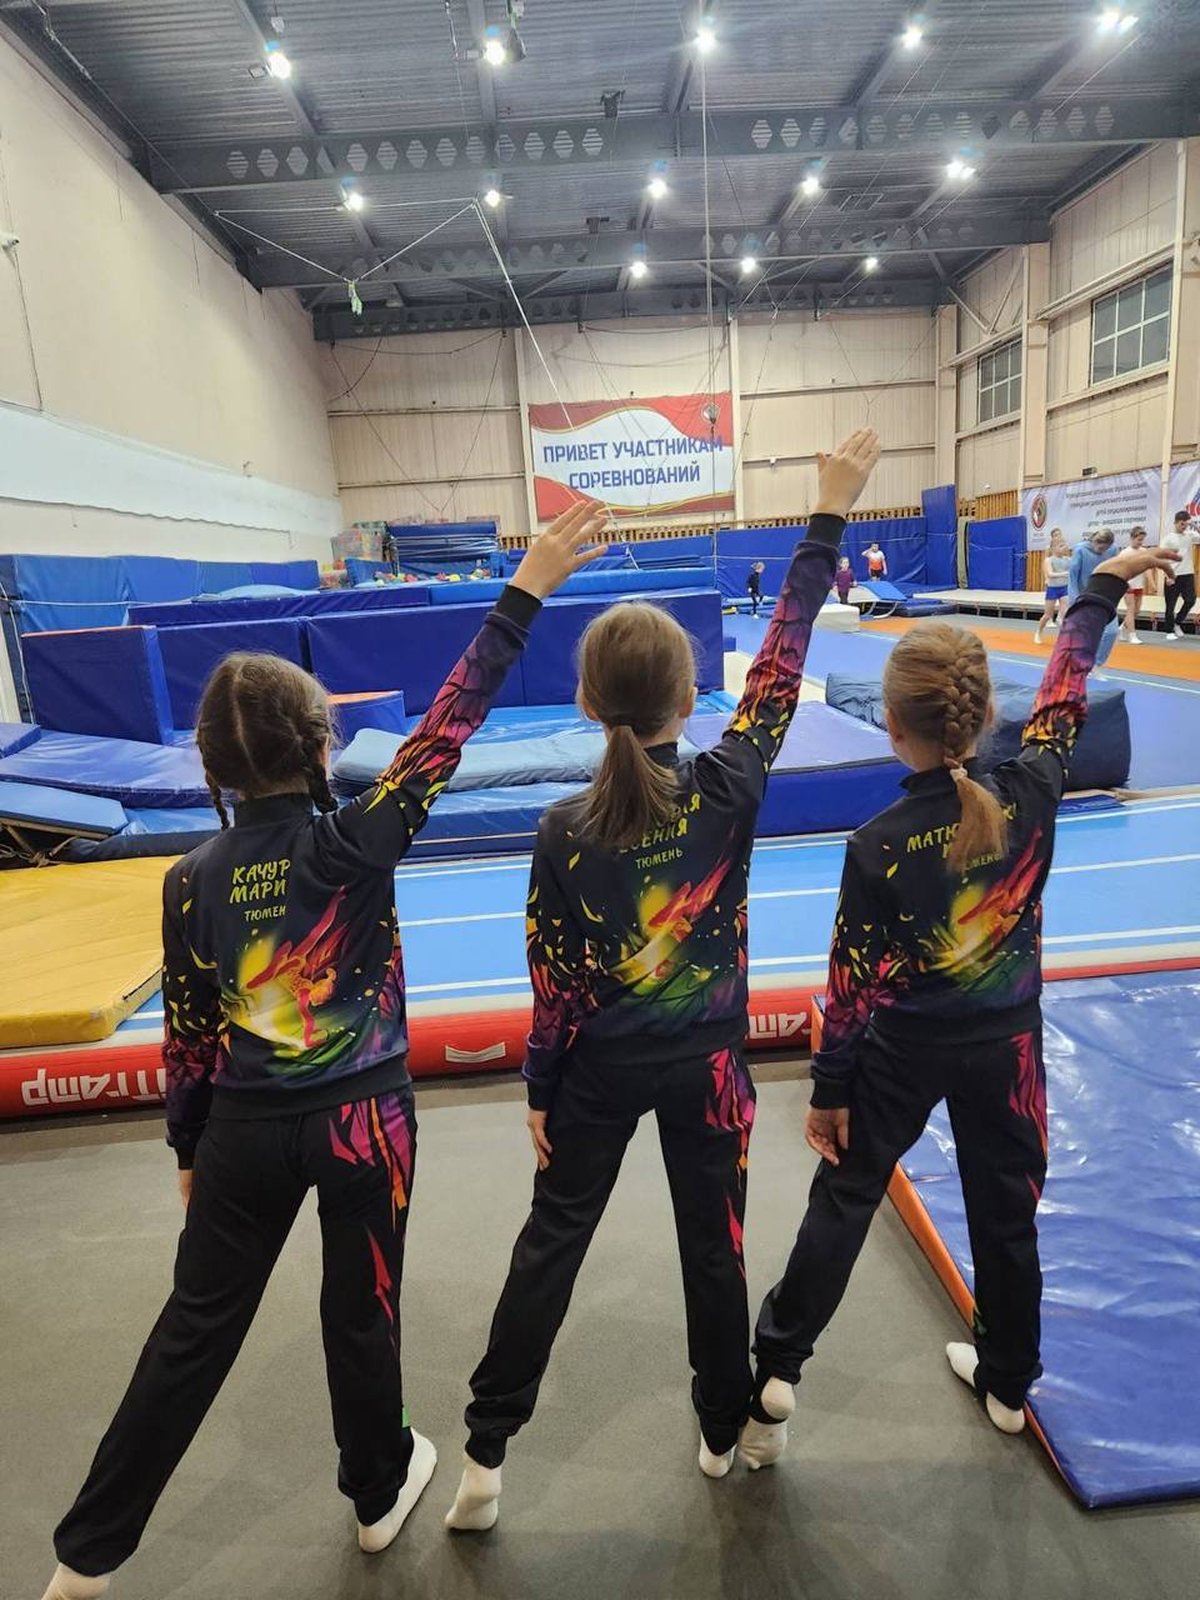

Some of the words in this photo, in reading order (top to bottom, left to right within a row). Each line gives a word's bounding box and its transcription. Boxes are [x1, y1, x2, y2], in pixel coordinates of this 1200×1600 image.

[543, 443, 608, 463] ПРИВЕТ
[613, 436, 723, 459] УЧАСТНИКАМ
[569, 461, 700, 490] СОРЕВНОВАНИЙ
[619, 817, 688, 854] ЕНИЯ
[232, 859, 291, 885] КАЧУР
[635, 847, 684, 870] ТЮМЕНЬ
